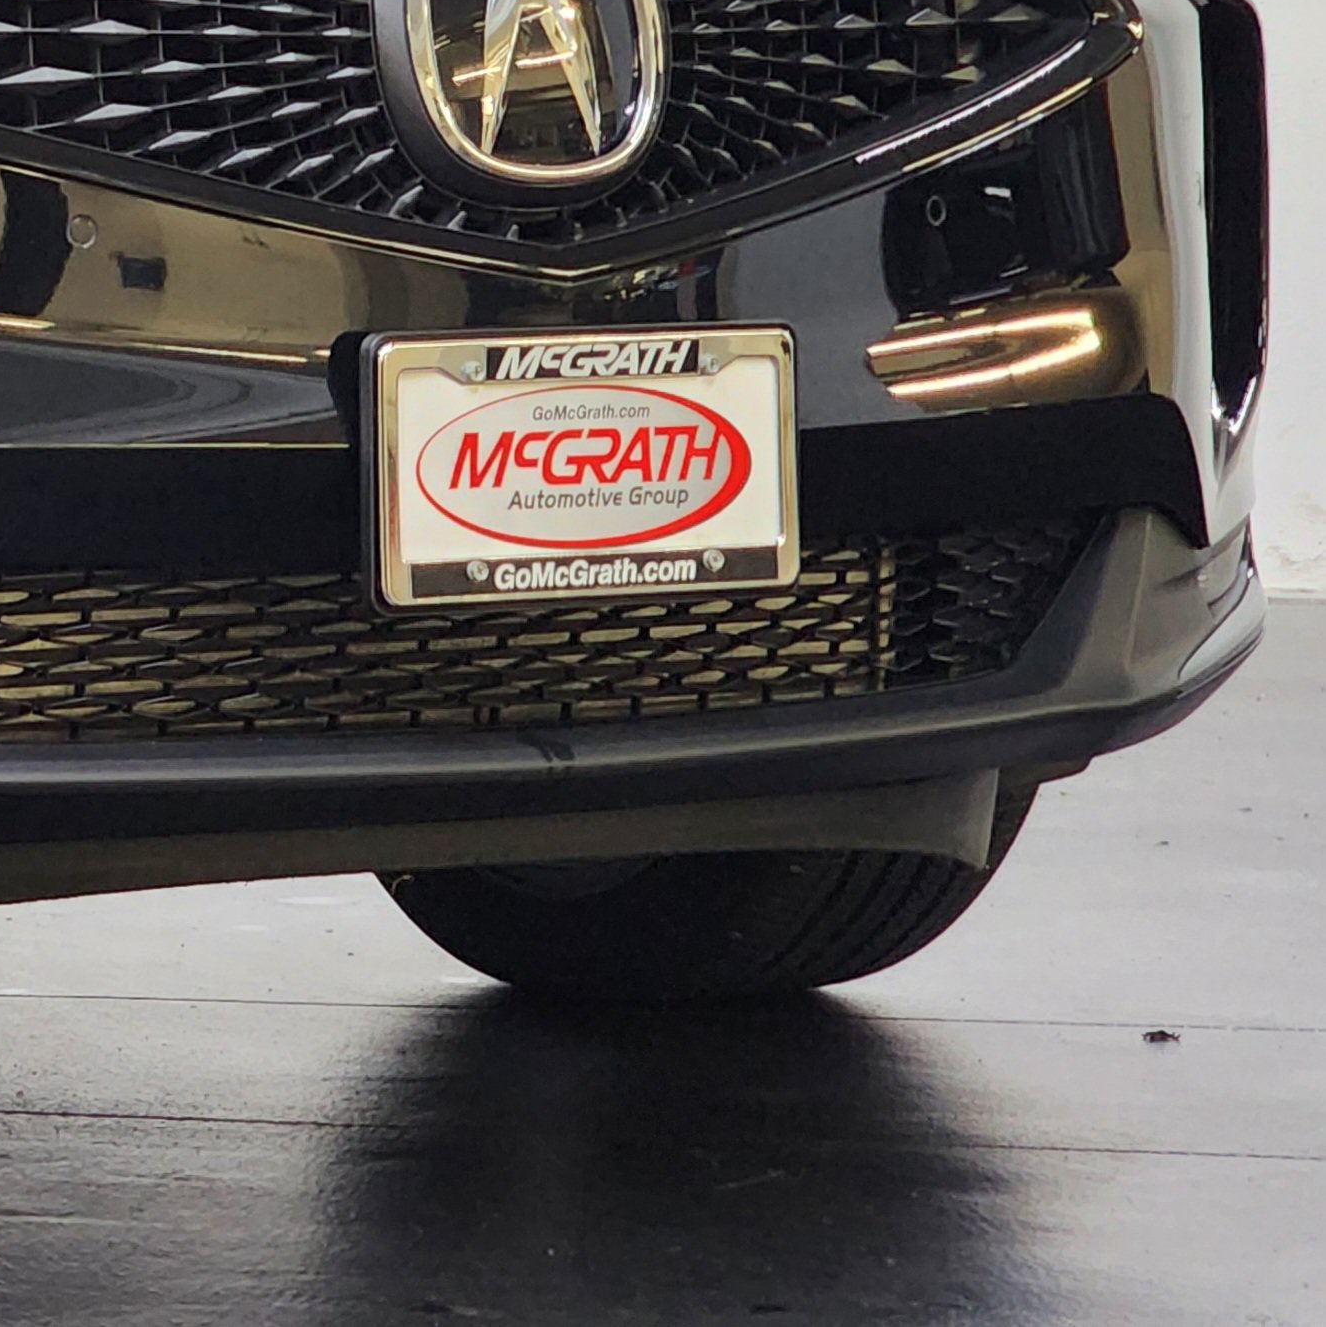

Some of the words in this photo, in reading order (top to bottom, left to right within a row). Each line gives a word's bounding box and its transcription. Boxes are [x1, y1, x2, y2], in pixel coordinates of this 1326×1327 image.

[532, 403, 650, 422] GoMcGrath.com
[507, 488, 623, 511] Automotive
[629, 486, 689, 509] Group
[494, 558, 697, 591] GoMcGrath.com
